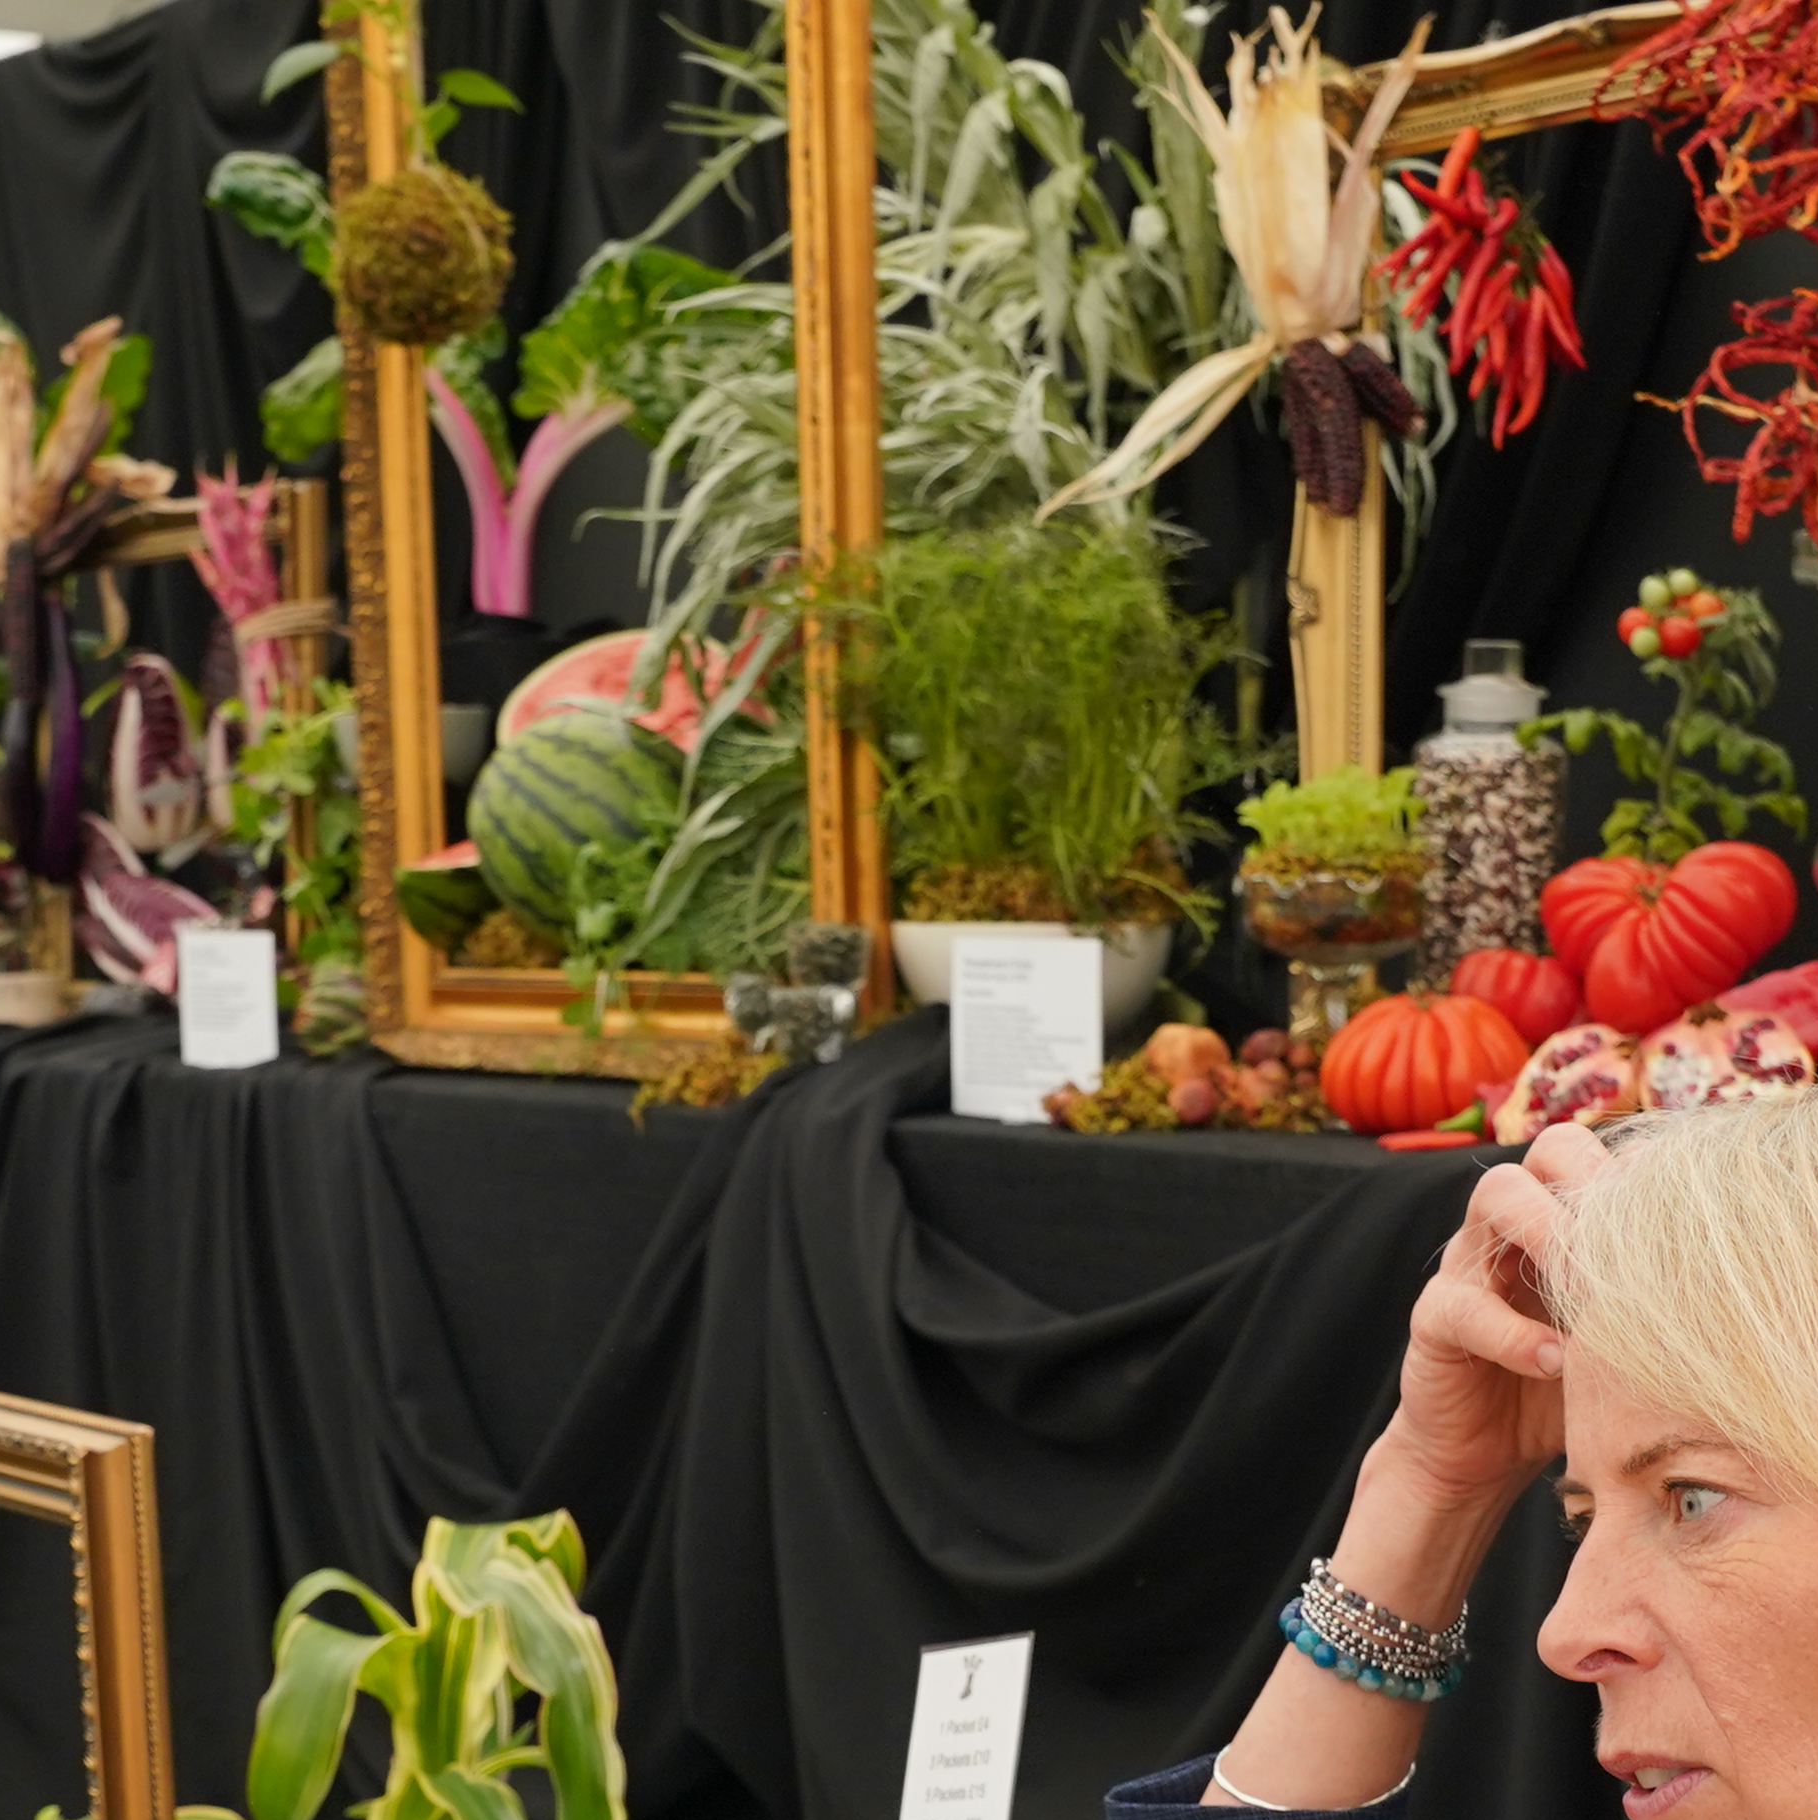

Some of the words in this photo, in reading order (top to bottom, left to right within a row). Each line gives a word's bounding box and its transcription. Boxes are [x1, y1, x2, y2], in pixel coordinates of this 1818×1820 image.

[947, 1719, 976, 1735] Packet
[936, 1752, 971, 1768] Packets
[972, 1749, 990, 1766] £10
[932, 1786, 966, 1801] Packets
[968, 1783, 985, 1800] £15
